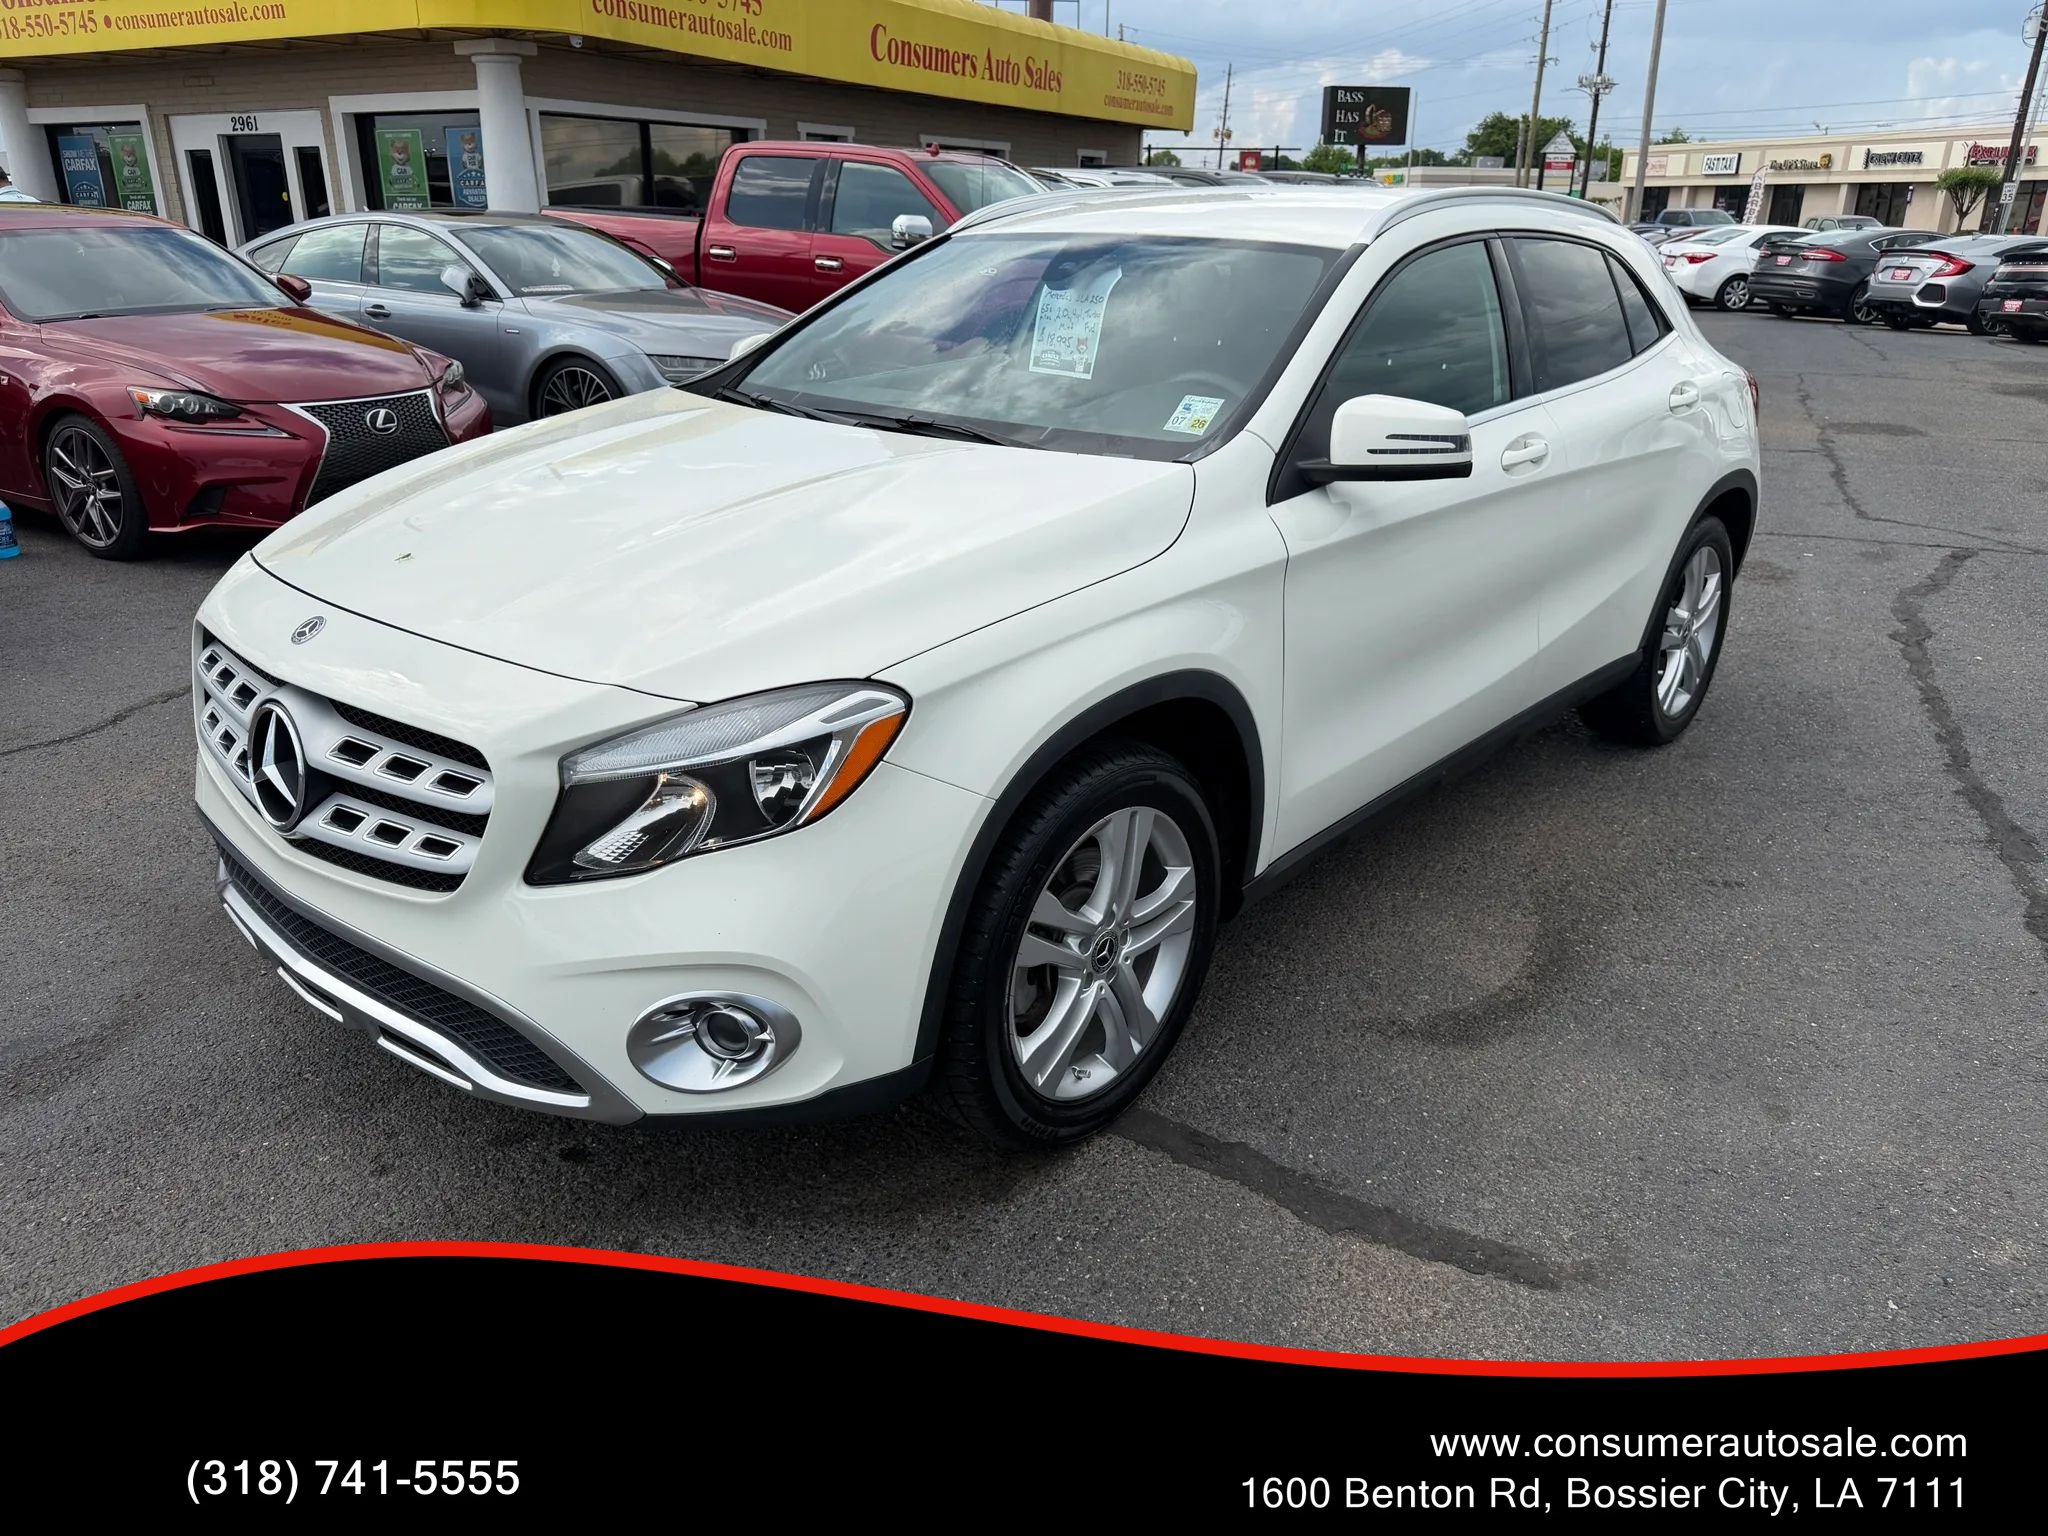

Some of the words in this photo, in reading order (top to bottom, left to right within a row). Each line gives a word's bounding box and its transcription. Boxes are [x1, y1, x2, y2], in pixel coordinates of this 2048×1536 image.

[0, 10, 98, 40] 18-550-5745
[115, 1, 287, 31] consumerautosale.com
[592, 0, 792, 51] consumerautosale.com
[870, 23, 978, 78] Consumers
[981, 48, 1021, 86] Auto
[1023, 56, 1064, 93] Sales
[1117, 70, 1166, 97] 318-550-5745
[1337, 89, 1365, 103] BASS
[1103, 95, 1175, 117] consumerautosale.com
[230, 115, 258, 132] 2961
[1335, 109, 1360, 123] HAS
[1334, 128, 1348, 142] IT
[64, 158, 97, 171] CARFAX
[2001, 193, 2014, 202] 35
[1171, 416, 1187, 425] 07
[1190, 418, 1207, 429] 26
